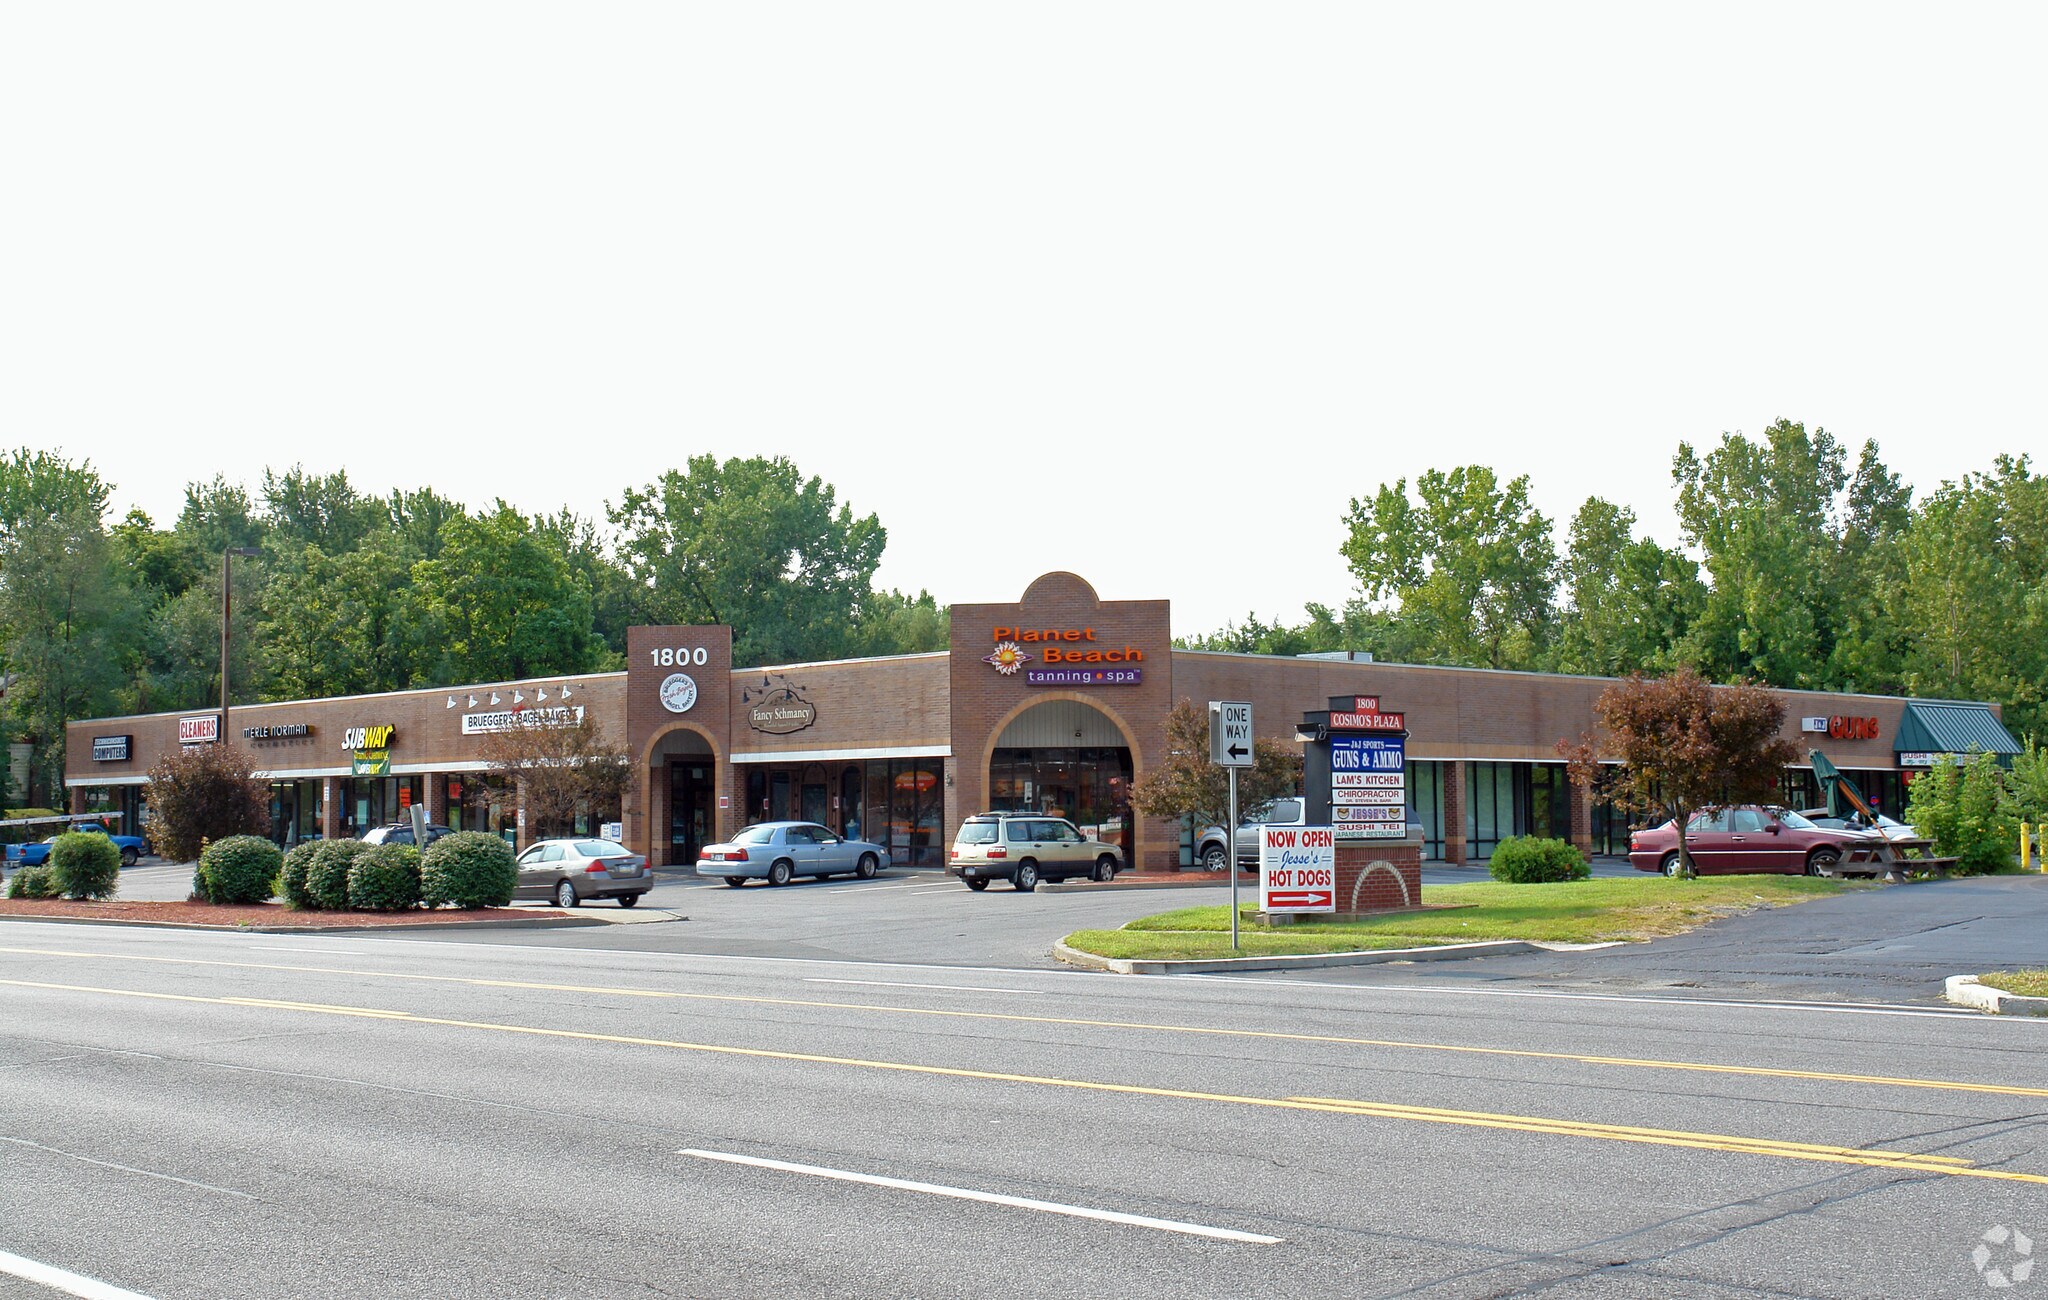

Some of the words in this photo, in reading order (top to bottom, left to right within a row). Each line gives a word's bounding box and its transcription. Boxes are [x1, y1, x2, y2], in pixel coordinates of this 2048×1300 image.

[993, 627, 1096, 642] Planet
[651, 648, 708, 666] 1800
[1043, 646, 1142, 663] Beach
[1028, 671, 1091, 683] tanning
[1107, 672, 1135, 682] spa
[1357, 699, 1376, 709] 1800
[468, 713, 513, 728] BRUEGGER'S
[753, 710, 773, 723] Fancy
[774, 708, 809, 721] Schmancy
[1226, 708, 1248, 722] ONE
[1333, 713, 1371, 727] COSIMO'S
[1374, 715, 1400, 728] PLAZA
[181, 720, 217, 739] CLEANERS
[243, 726, 268, 739] MERLE
[270, 723, 306, 737] NORMAN
[1226, 725, 1248, 739] WAY
[1829, 716, 1879, 740] GUNS
[341, 725, 394, 750] SUBWAY
[1363, 741, 1385, 749] SPORTS
[94, 746, 126, 760] COMPUTERS
[1332, 749, 1359, 768] GUNS
[1362, 753, 1370, 767] &
[1372, 750, 1402, 768] AMMO
[1336, 775, 1362, 785] LAM'S
[1365, 775, 1400, 785] KITCHEN
[1337, 790, 1400, 798] CHIROPRACTOR
[1351, 808, 1388, 819] JESSE'S
[1338, 823, 1375, 831] SUSHI
[1267, 831, 1297, 848] NOW
[1301, 831, 1332, 848] OPEN
[1281, 850, 1319, 870] Jesse's
[1269, 870, 1292, 887] HOT
[1297, 869, 1331, 887] DOGS
